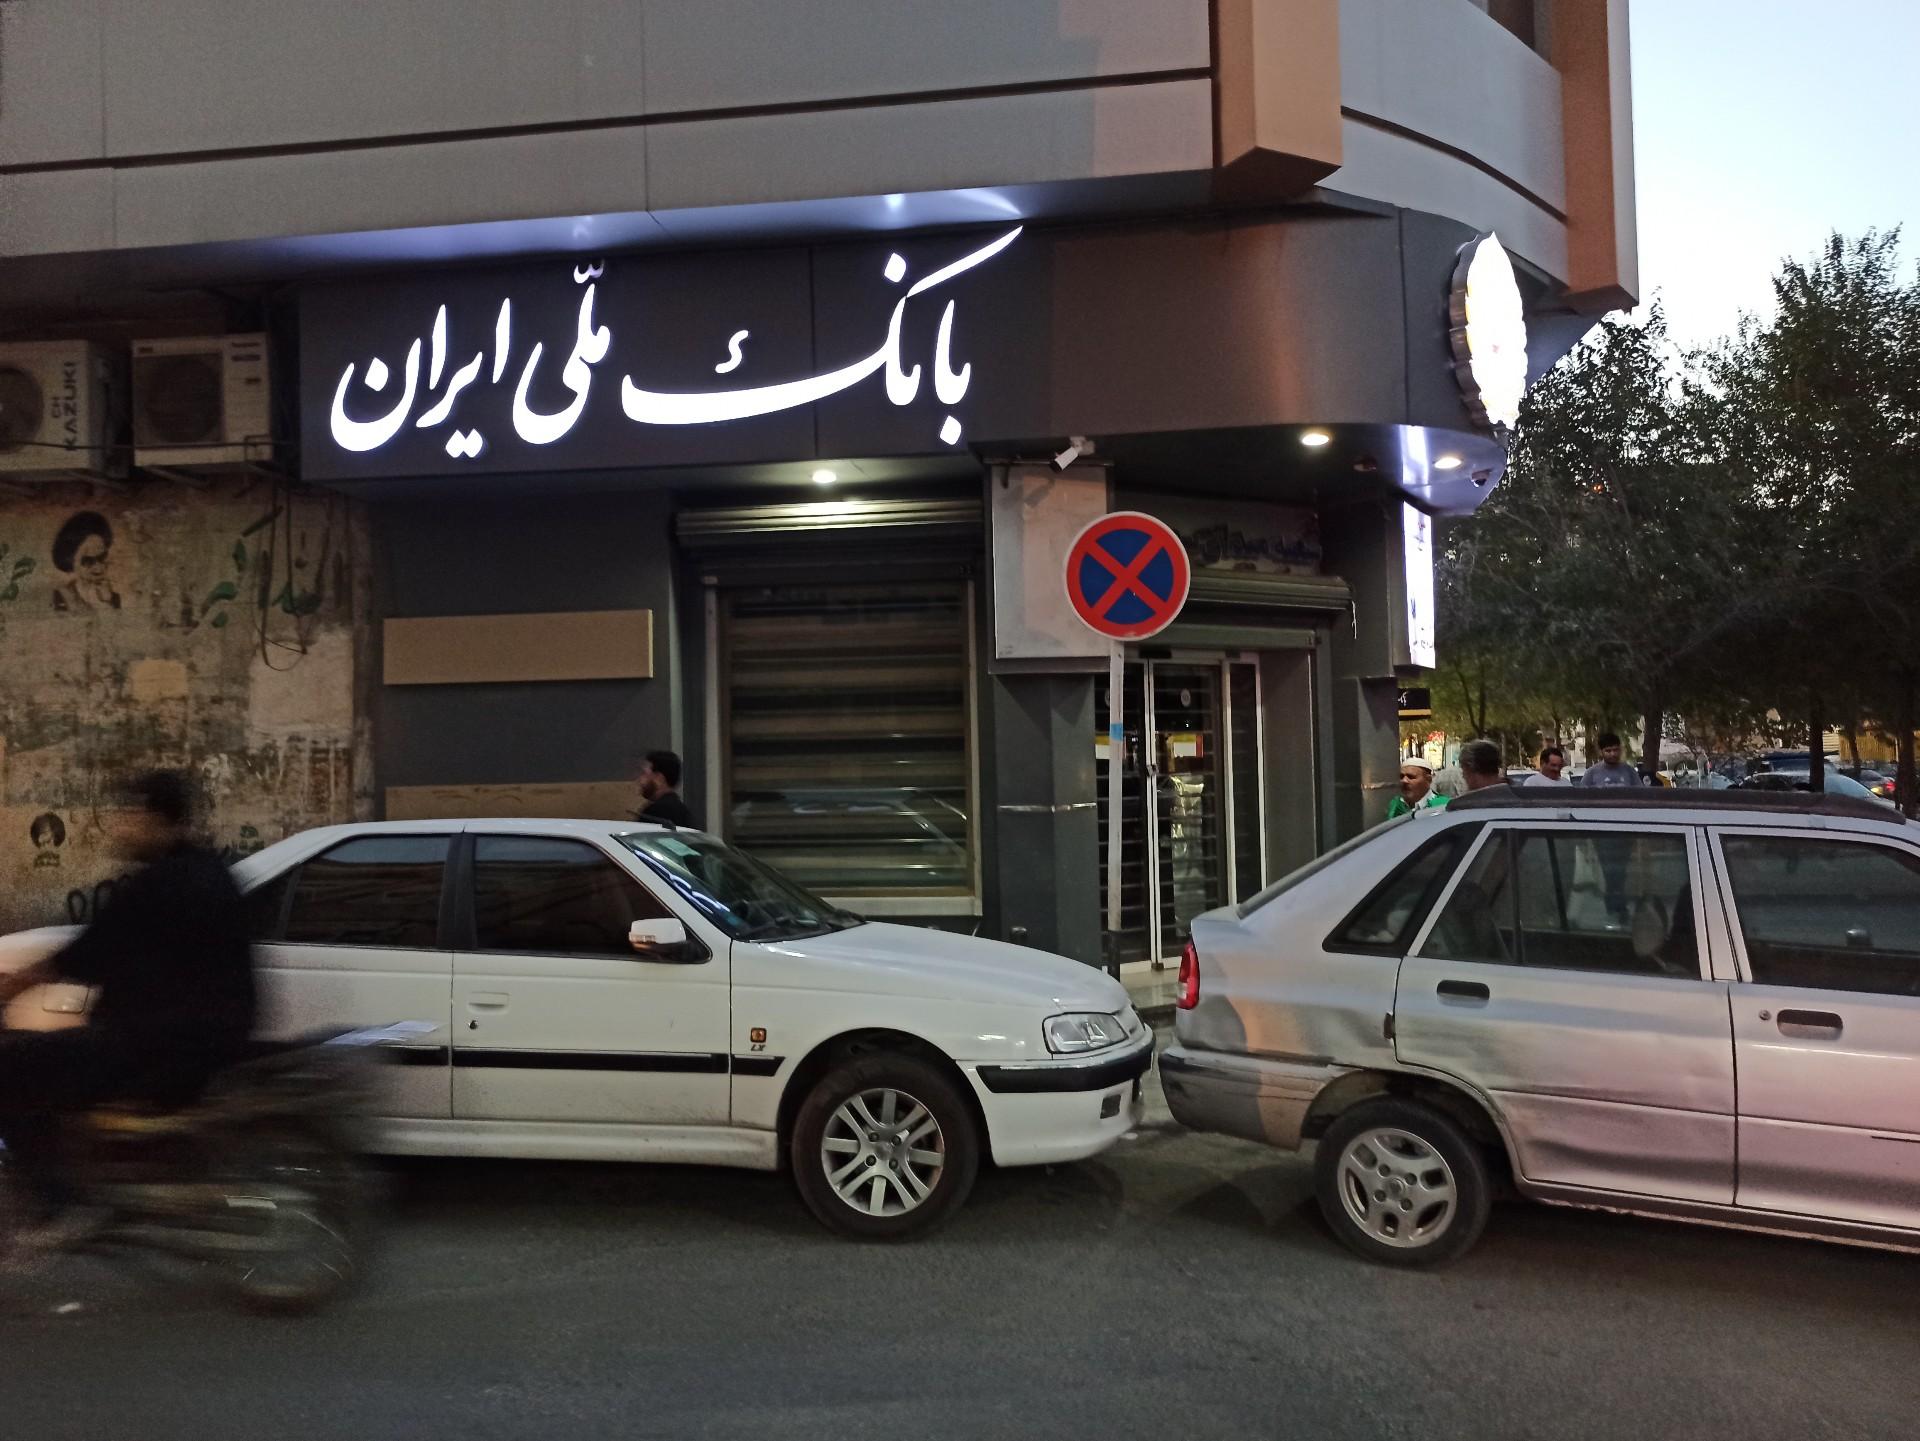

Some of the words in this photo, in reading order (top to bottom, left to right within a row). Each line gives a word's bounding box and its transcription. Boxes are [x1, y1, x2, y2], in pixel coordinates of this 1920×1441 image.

[63, 360, 78, 451] KAZUKI
[330, 297, 511, 458] ایران
[750, 1043, 766, 1052] LX
